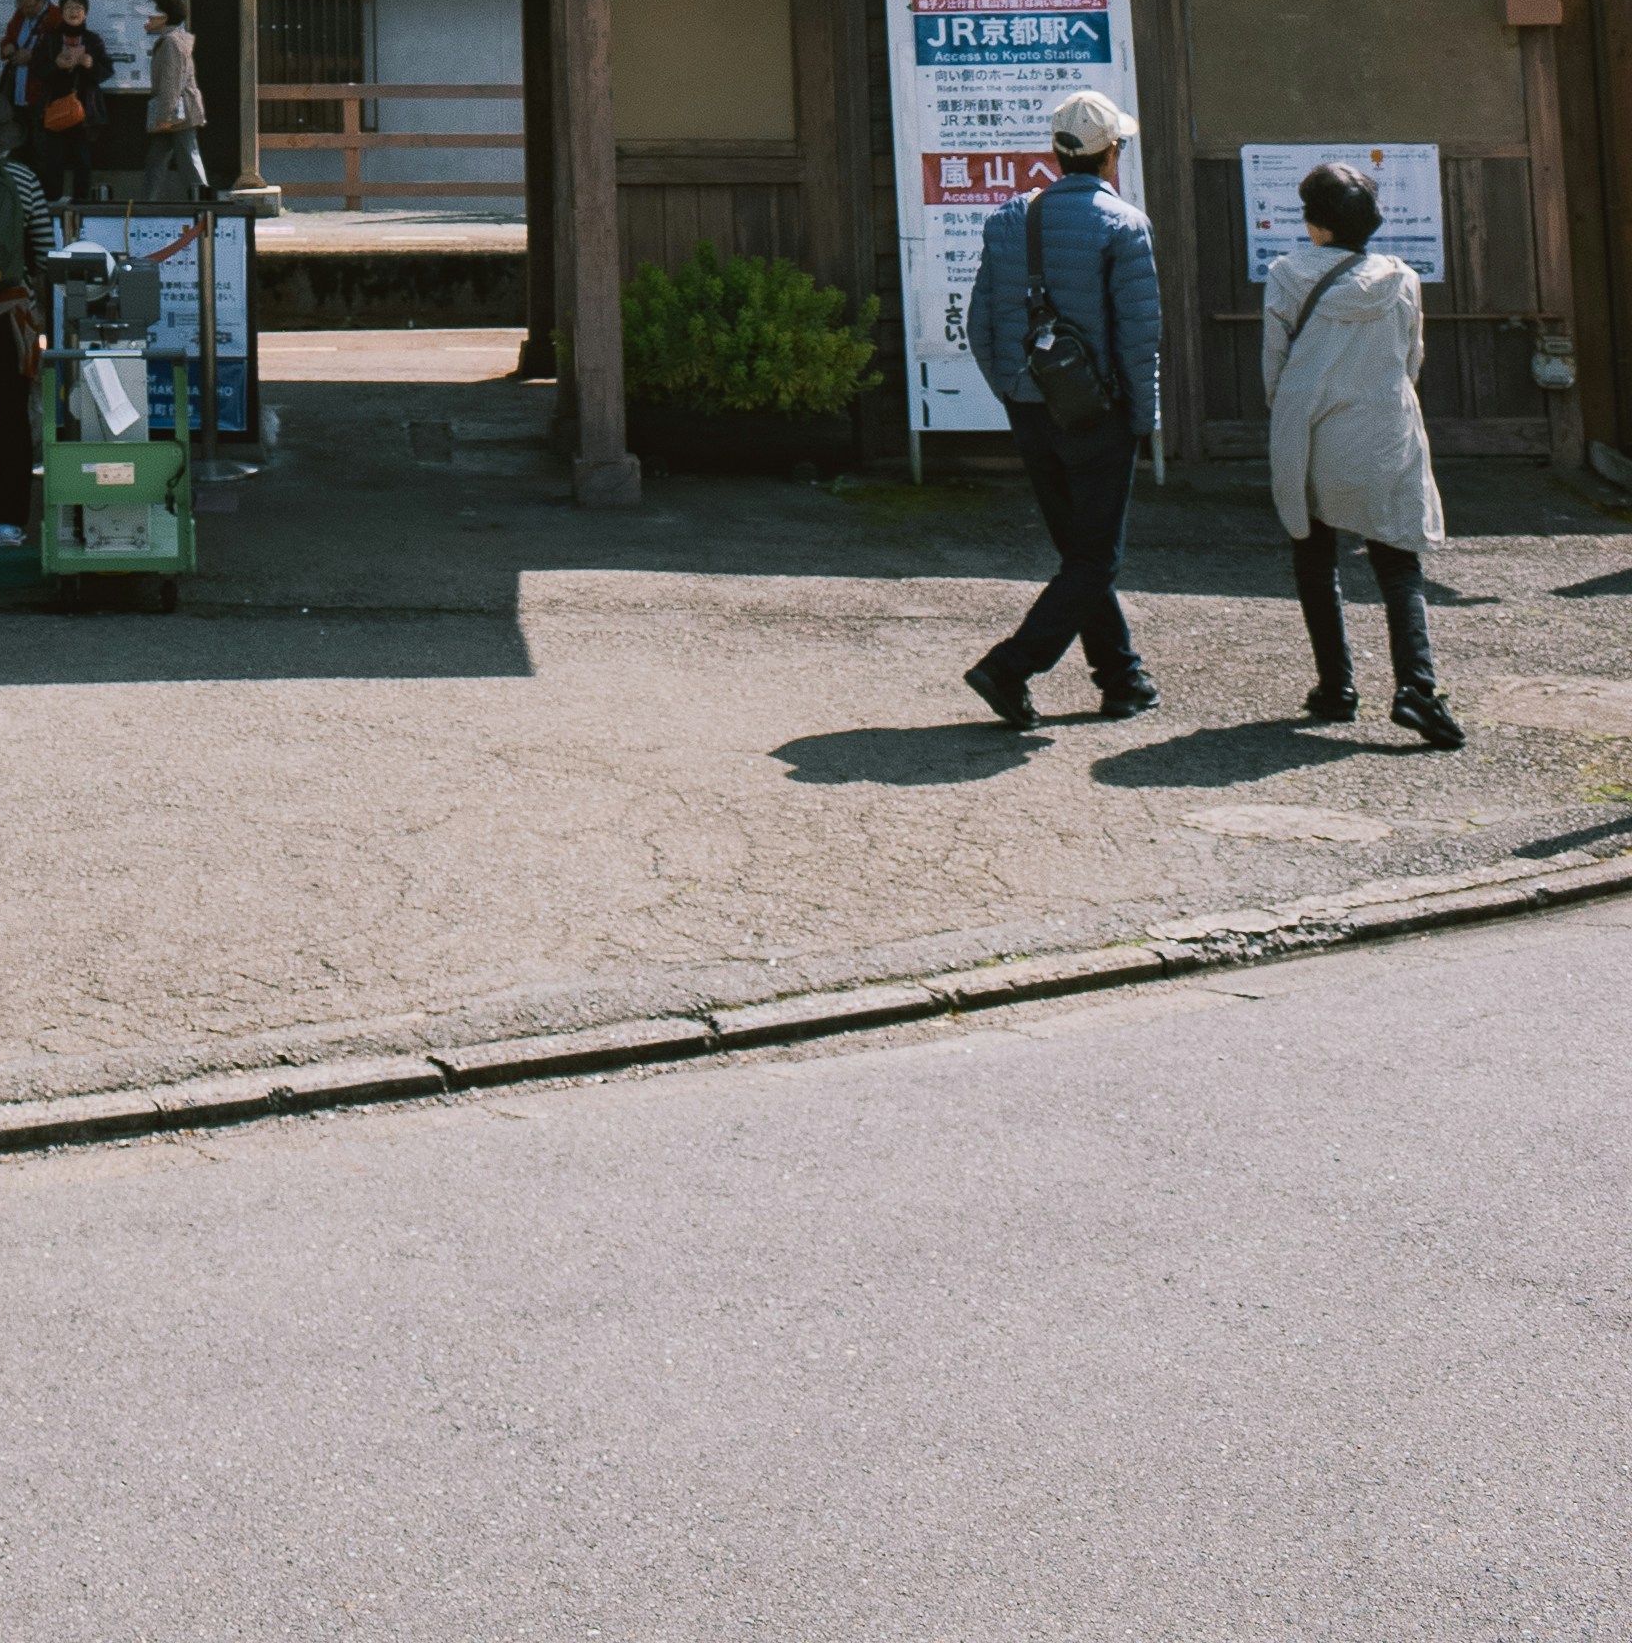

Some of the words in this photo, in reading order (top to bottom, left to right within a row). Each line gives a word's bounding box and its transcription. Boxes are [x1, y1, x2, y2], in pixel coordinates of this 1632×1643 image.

[927, 16, 1099, 47] JR京都駅へ
[934, 50, 981, 62] Access
[984, 51, 999, 62] to
[1002, 50, 1041, 63] Kyoto
[1044, 49, 1091, 61] Station
[961, 84, 984, 93] from
[986, 84, 1002, 93] the
[1005, 84, 1048, 95] opposite
[940, 156, 1058, 188] 嵐山へ
[942, 192, 990, 202] Access
[993, 192, 1008, 202] to
